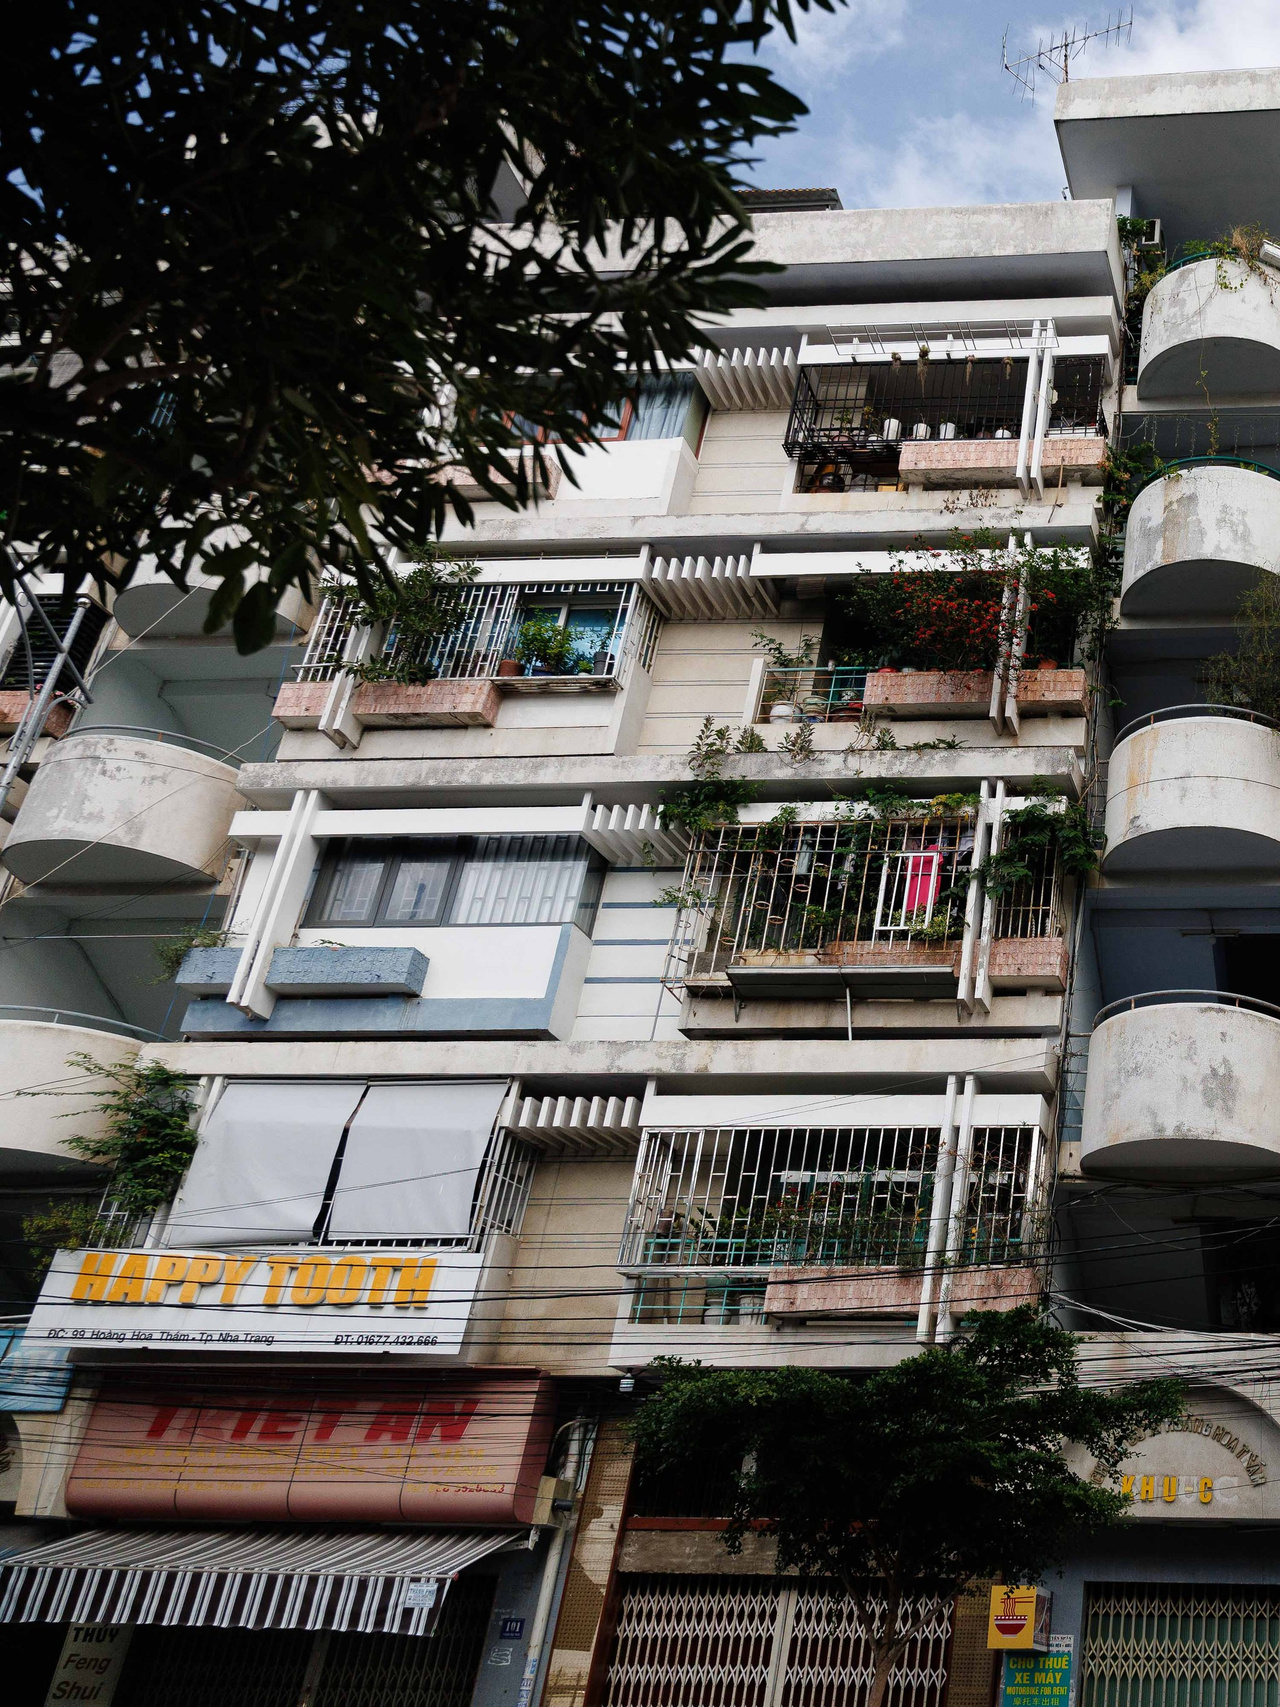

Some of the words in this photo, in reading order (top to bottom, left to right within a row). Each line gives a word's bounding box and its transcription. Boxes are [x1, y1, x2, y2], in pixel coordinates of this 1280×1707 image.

[70, 1253, 260, 1305] HAPPY
[263, 1255, 438, 1307] TOOTH
[90, 1330, 126, 1343] Hoàng
[131, 1331, 154, 1341] Hoa
[159, 1331, 189, 1342] Thám
[218, 1332, 240, 1343] Nha
[243, 1333, 275, 1347] Trang
[506, 1621, 521, 1632] 101
[63, 1653, 112, 1675] Feng
[1009, 1656, 1034, 1669] CHO
[1038, 1655, 1069, 1669] THUÊ
[1015, 1672, 1030, 1684] XE
[1034, 1670, 1063, 1684] MÁY
[52, 1680, 104, 1700] Shui
[1040, 1686, 1052, 1695] FOR
[1053, 1686, 1068, 1696] RENT
